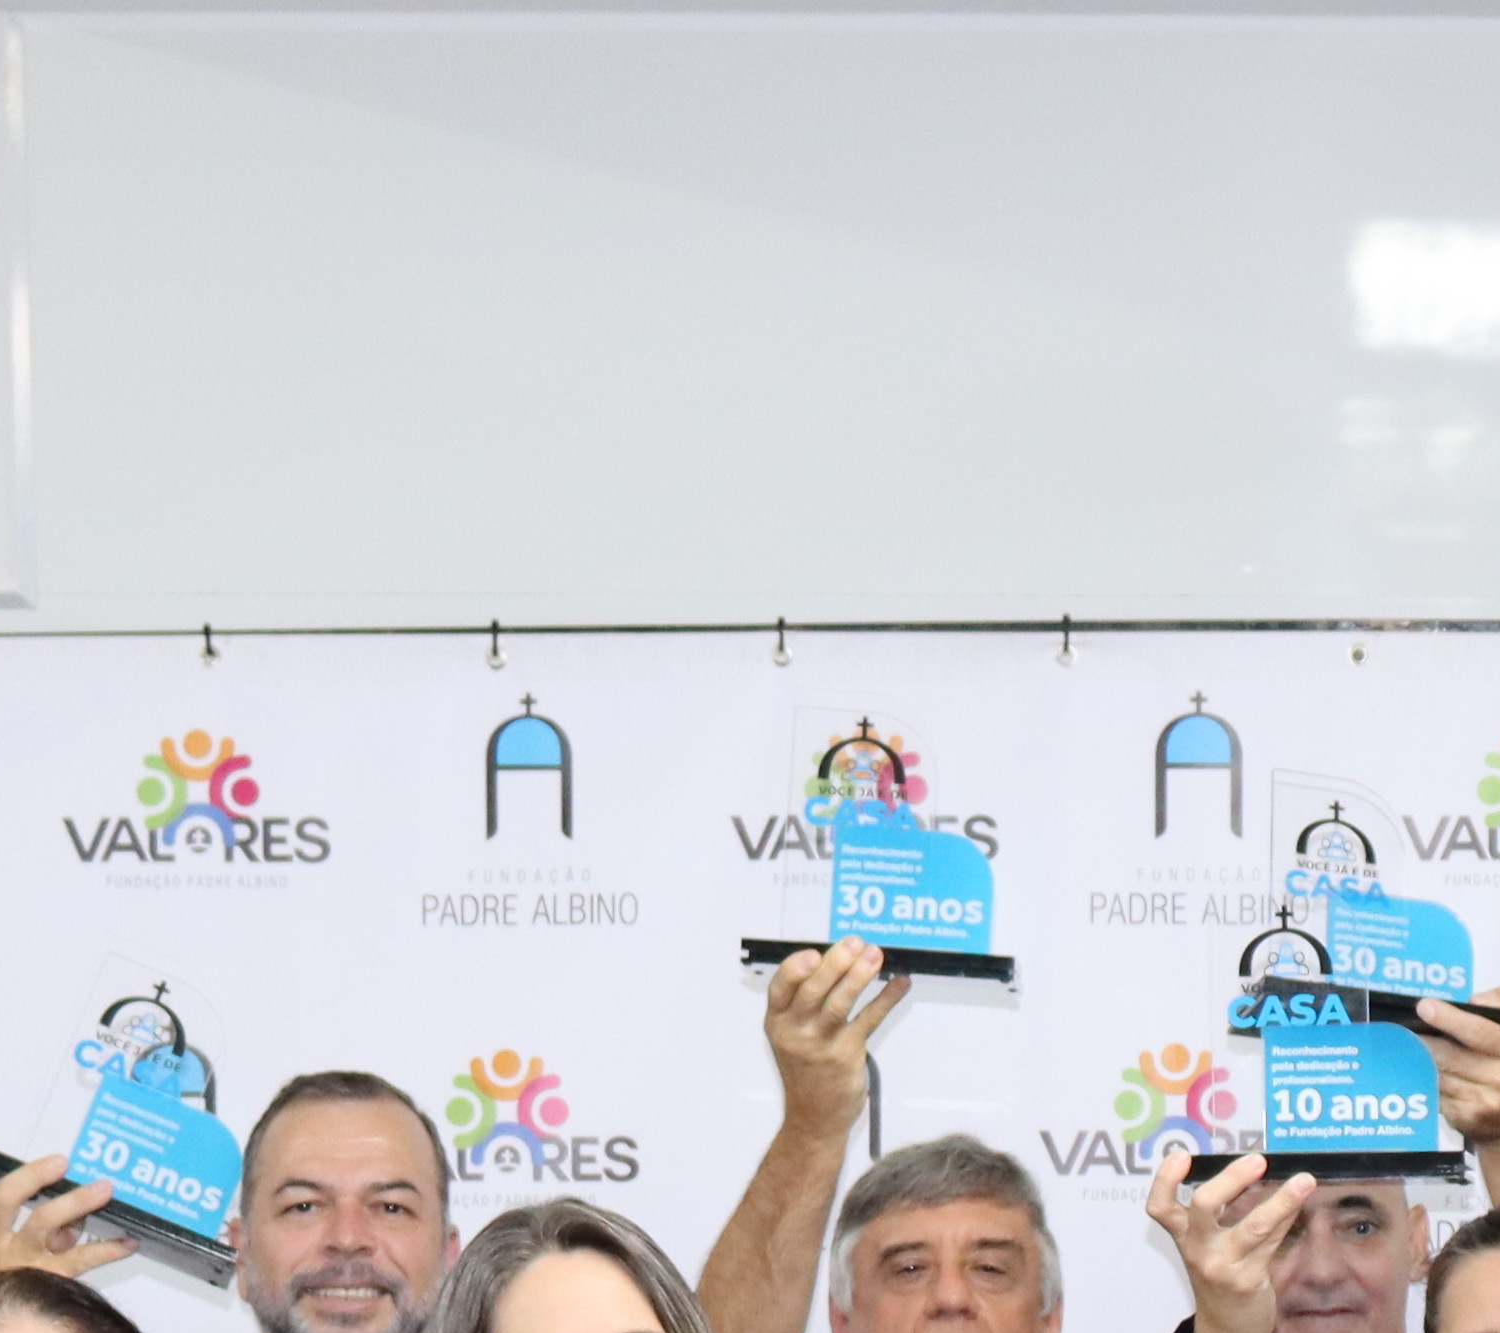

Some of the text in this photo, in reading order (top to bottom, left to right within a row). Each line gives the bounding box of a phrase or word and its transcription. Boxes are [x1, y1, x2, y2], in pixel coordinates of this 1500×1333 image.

[837, 884, 984, 924] 30 anos
[1285, 870, 1389, 906] CASA
[422, 892, 639, 926] PADRE ALBINO
[1090, 893, 1186, 925] PADRE
[1333, 945, 1467, 988] 30 anos
[1227, 993, 1352, 1029] CASA
[1274, 1088, 1429, 1122] 10 anos
[79, 1130, 224, 1213] 30 anos
